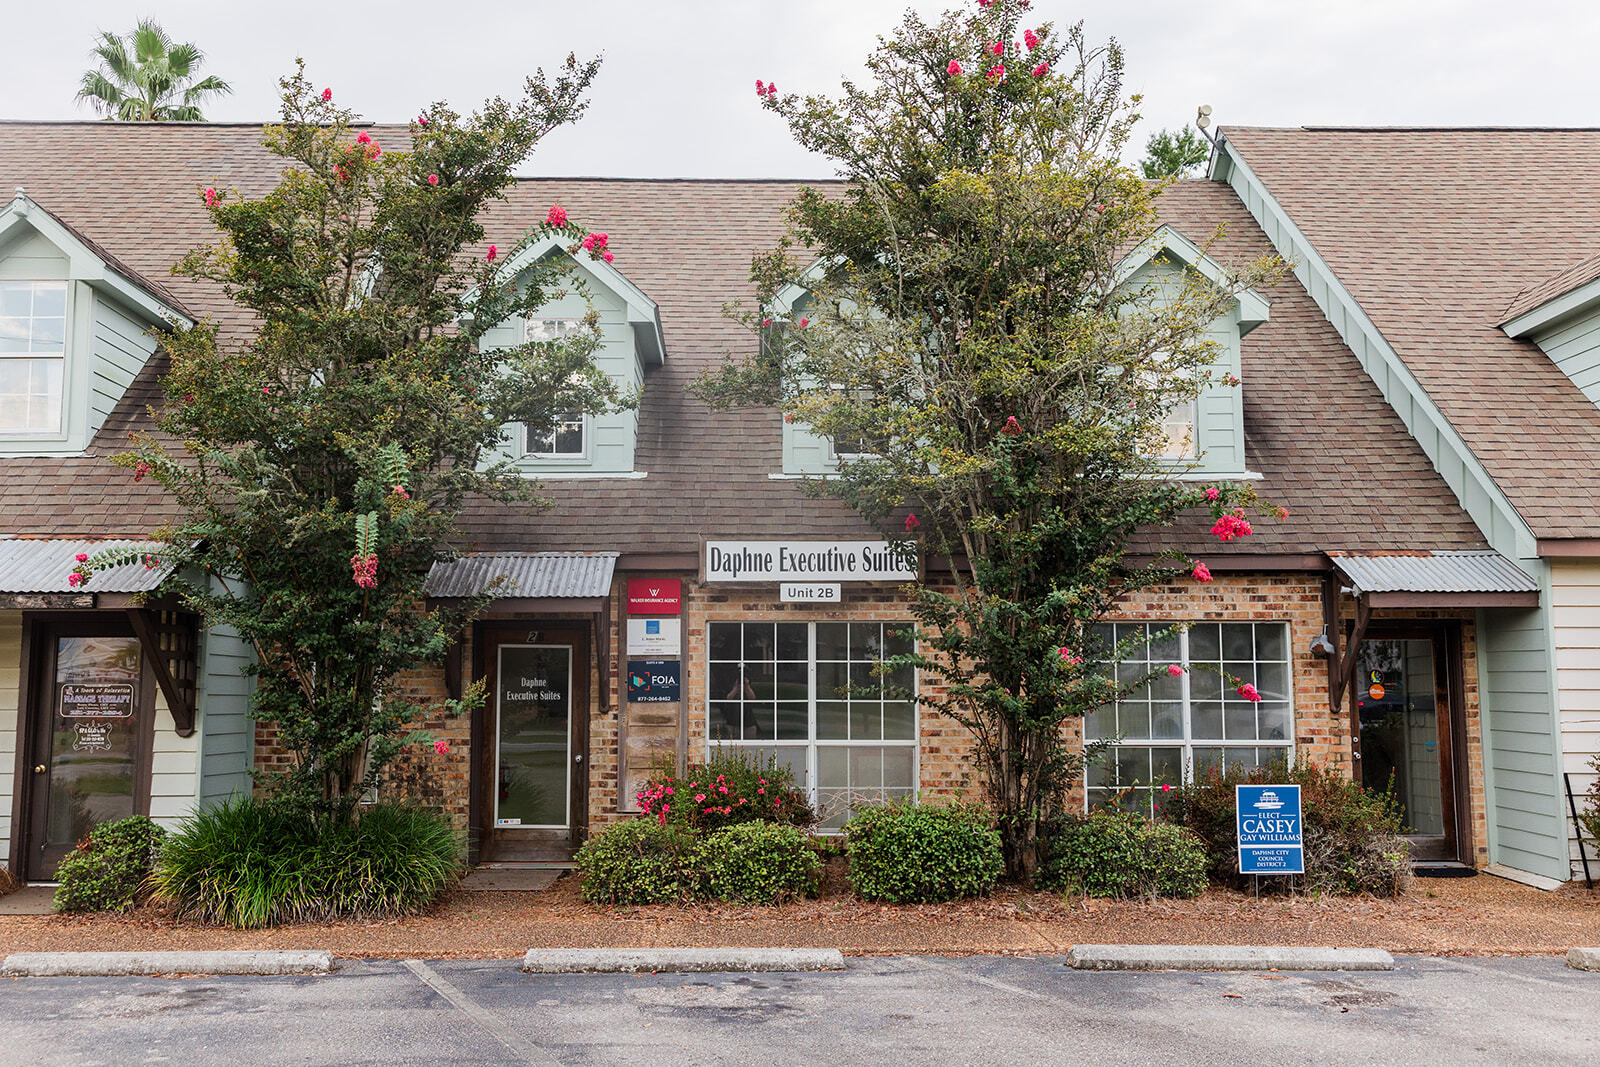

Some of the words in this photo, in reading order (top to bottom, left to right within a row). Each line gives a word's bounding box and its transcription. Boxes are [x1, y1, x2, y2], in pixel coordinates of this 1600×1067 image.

[710, 547, 773, 577] Daphne
[779, 547, 856, 572] Executive
[862, 546, 913, 572] Suites
[788, 587, 814, 598] Unit
[817, 587, 834, 598] 2B
[521, 677, 547, 688] Daphne
[651, 675, 676, 684] FOIA
[506, 690, 538, 700] Executive
[540, 690, 561, 700] Suites
[1242, 819, 1296, 833] CASEY
